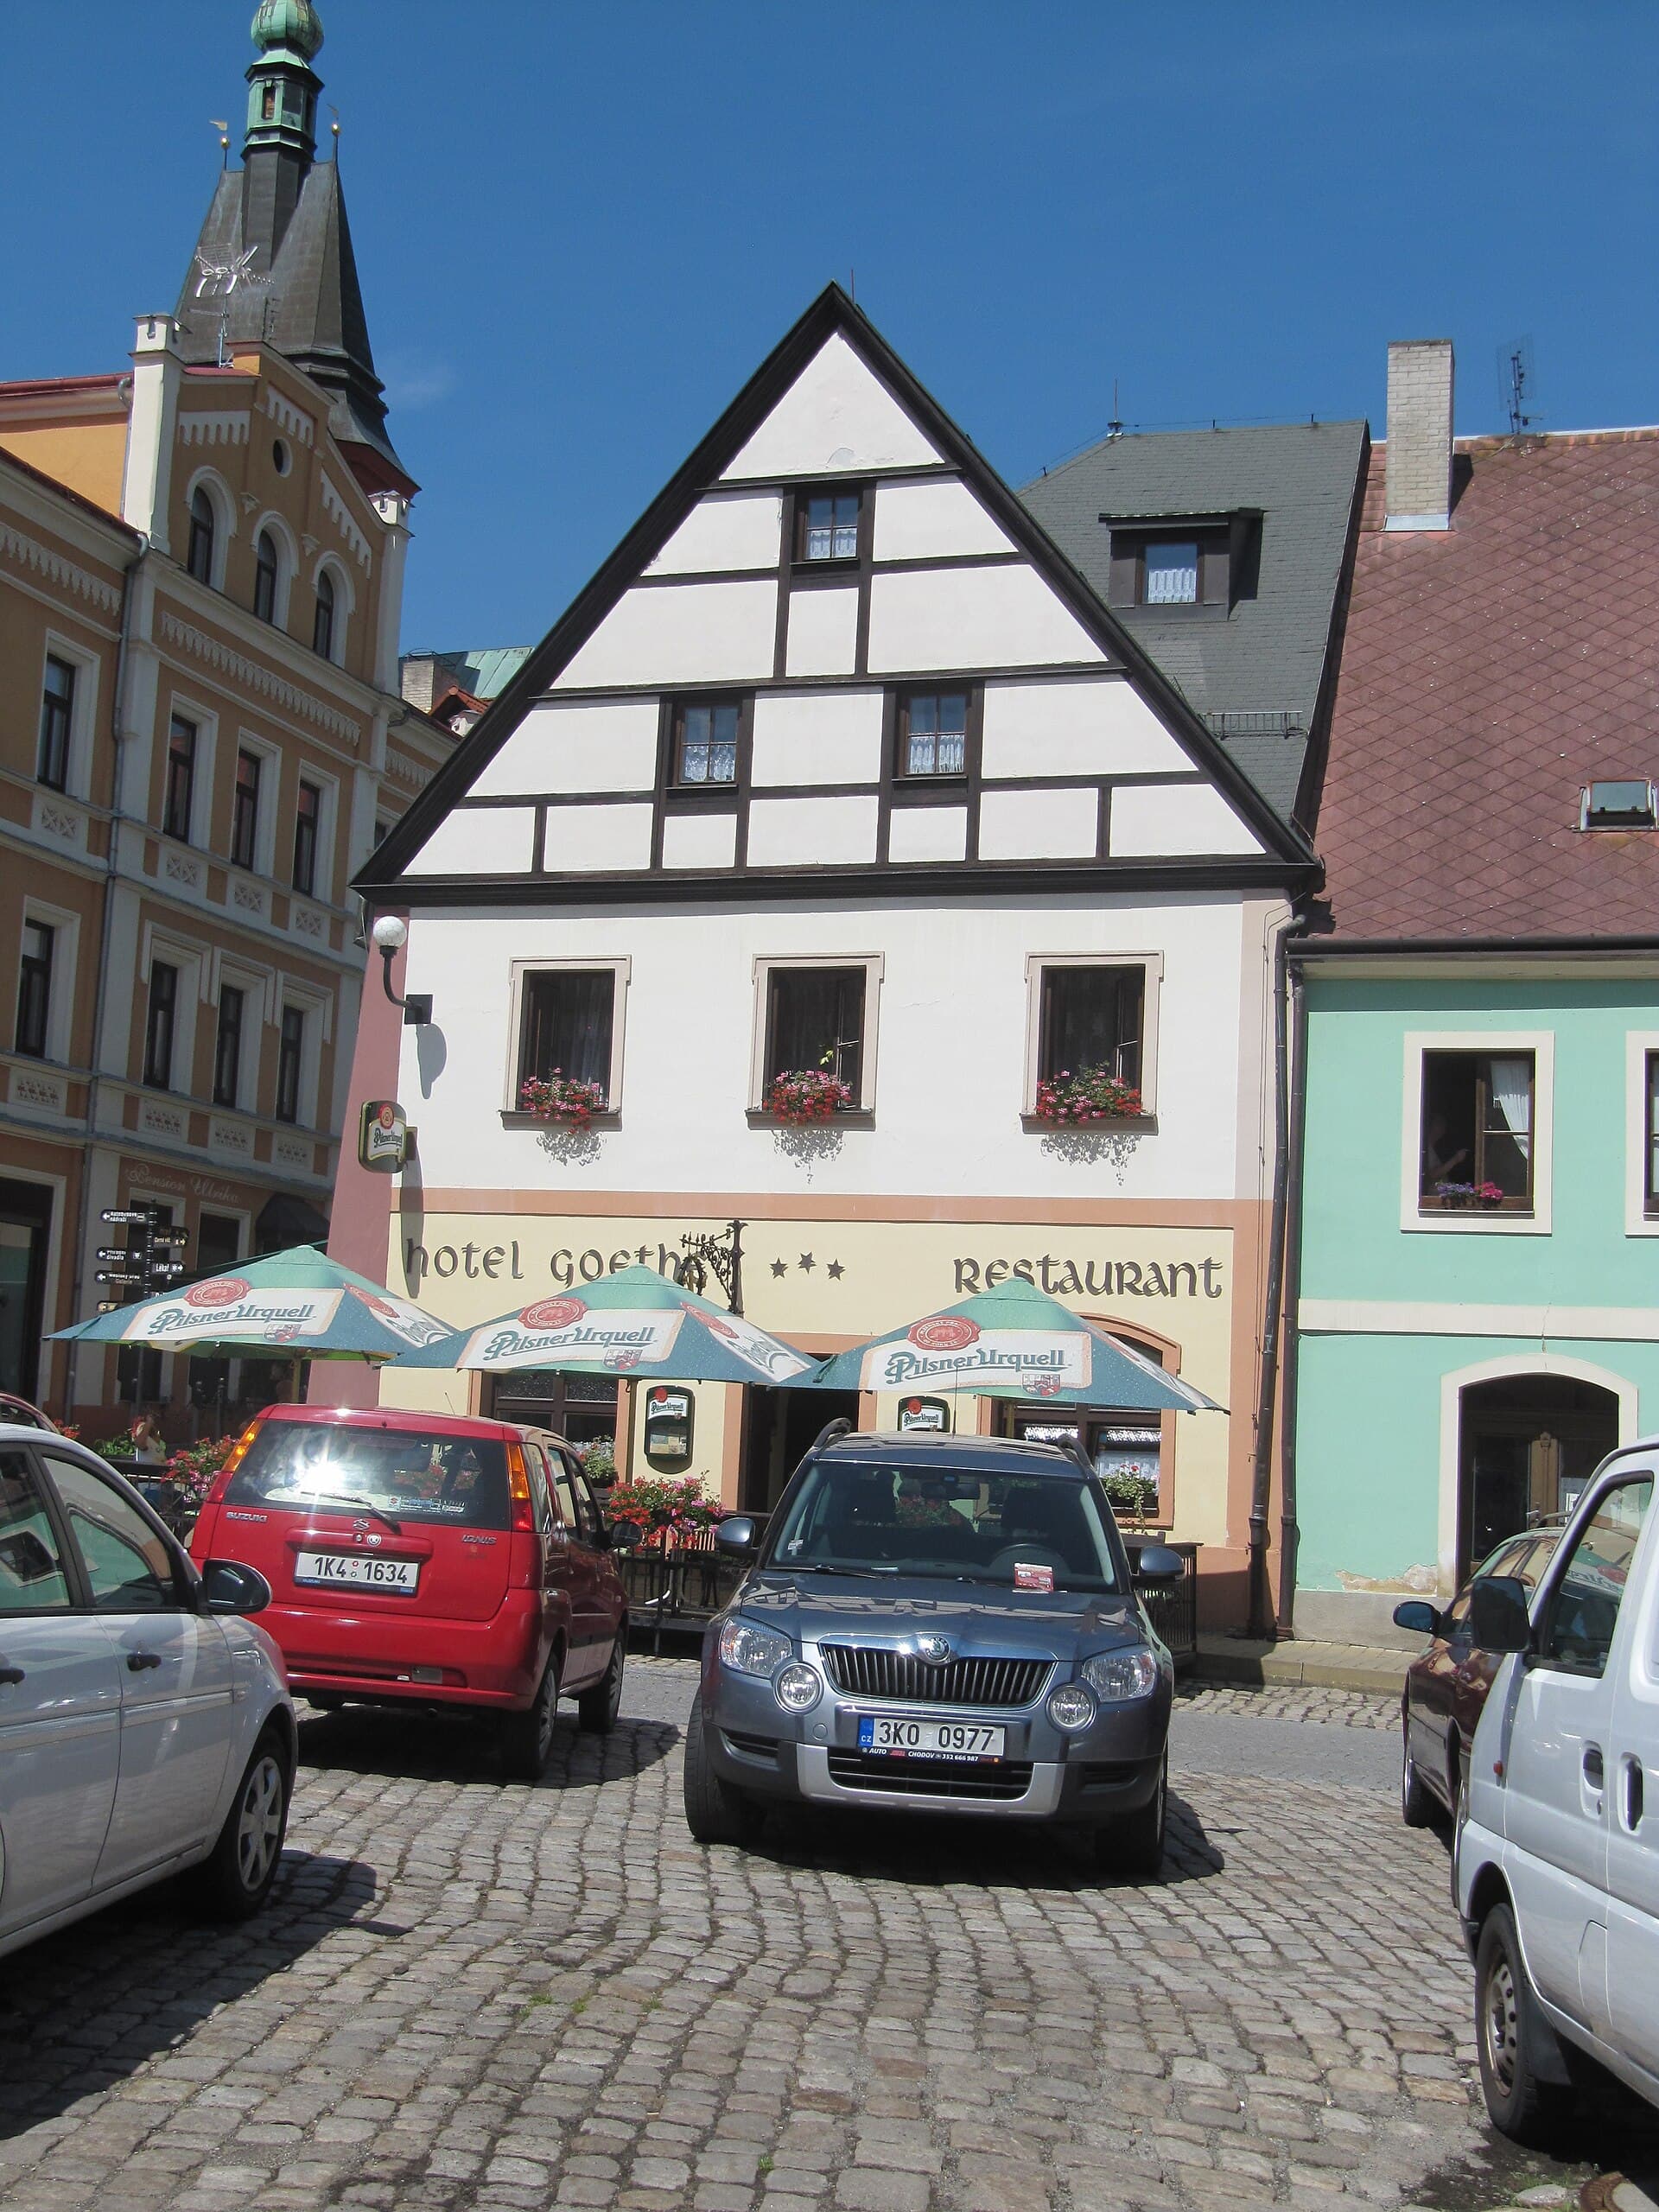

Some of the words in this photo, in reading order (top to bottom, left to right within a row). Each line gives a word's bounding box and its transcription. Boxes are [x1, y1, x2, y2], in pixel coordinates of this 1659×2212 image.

[147, 1308, 237, 1335] Pilsner
[236, 1304, 316, 1324] Urquell
[482, 1330, 574, 1361] Pilsner
[573, 1325, 656, 1348] Urquell
[884, 1351, 978, 1384] Pilsner
[976, 1348, 1067, 1372] Urquell
[226, 1511, 268, 1523] SUZUKI
[315, 1556, 346, 1578] 1K4
[364, 1561, 408, 1584] 1634
[861, 1734, 872, 1743] CZ
[868, 1747, 887, 1756] AUTO
[938, 1726, 995, 1751] 0977
